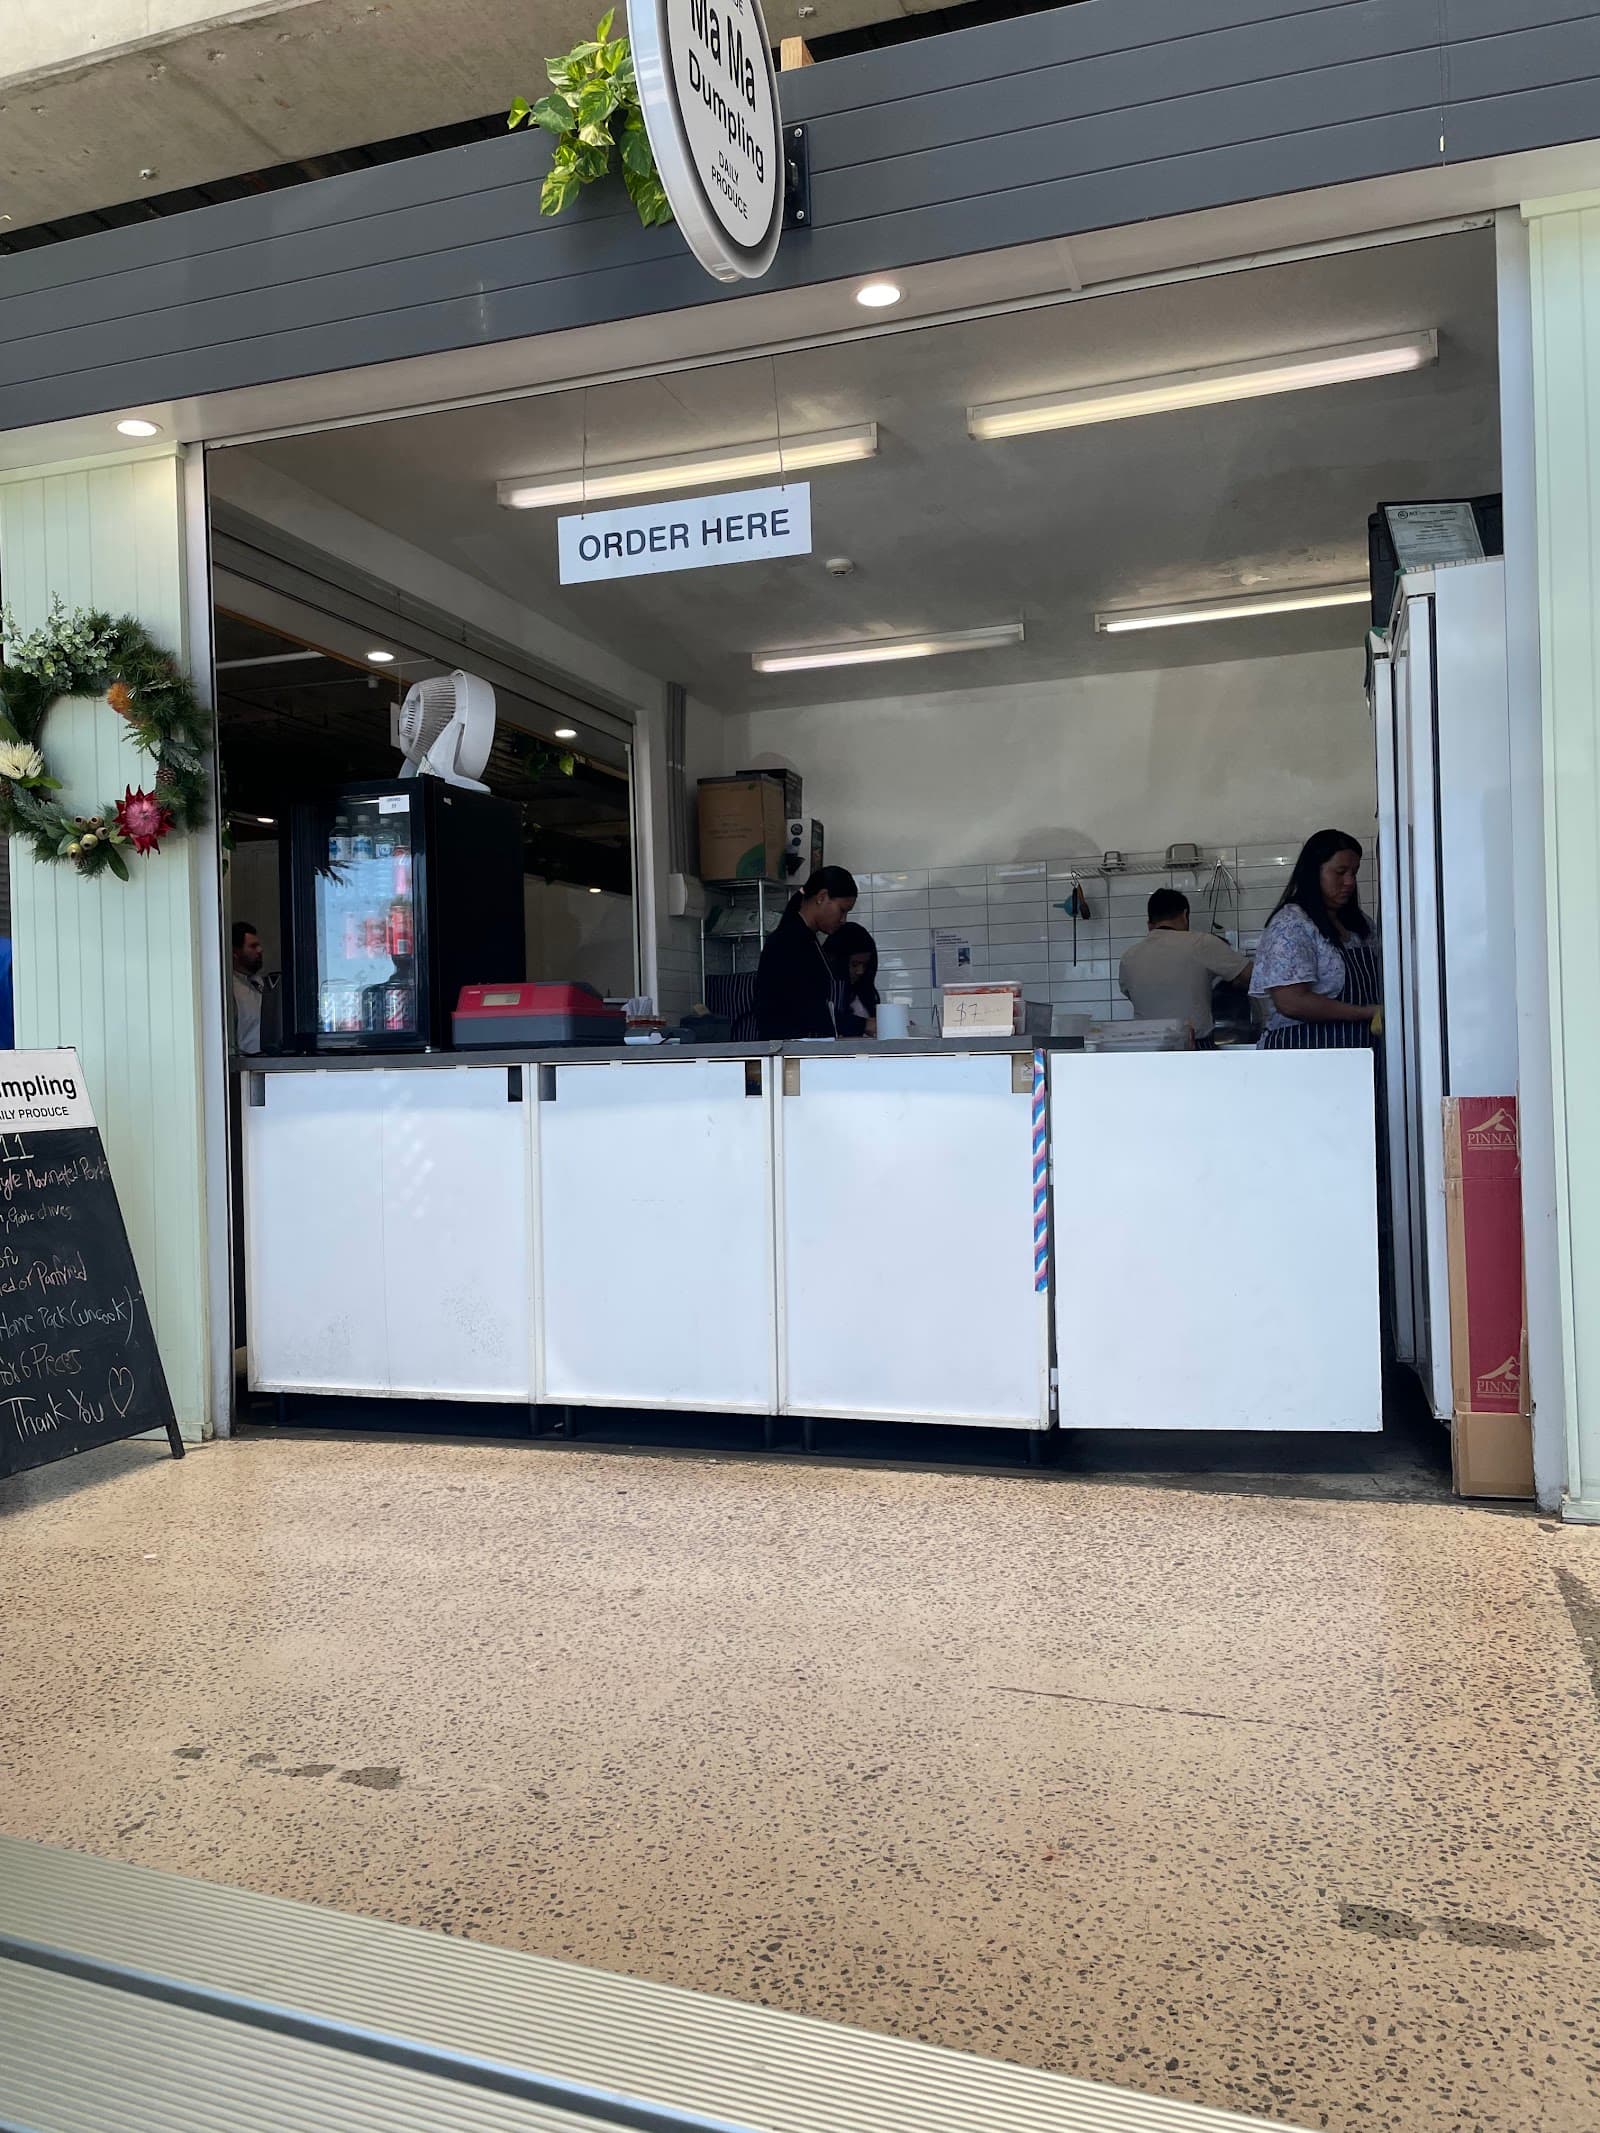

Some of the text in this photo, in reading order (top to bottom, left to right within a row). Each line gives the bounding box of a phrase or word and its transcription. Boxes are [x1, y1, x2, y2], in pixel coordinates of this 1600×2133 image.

[727, 15, 757, 112] Ma
[688, 48, 764, 183] Dumpling
[711, 165, 749, 220] PRODUCE
[718, 150, 738, 187] DAILY
[579, 508, 790, 561] ORDER HERE
[0, 1075, 77, 1102] mpling
[18, 1106, 70, 1119] PRODUCE
[1467, 1132, 1517, 1144] PINNA
[0, 1393, 72, 1443] Thank
